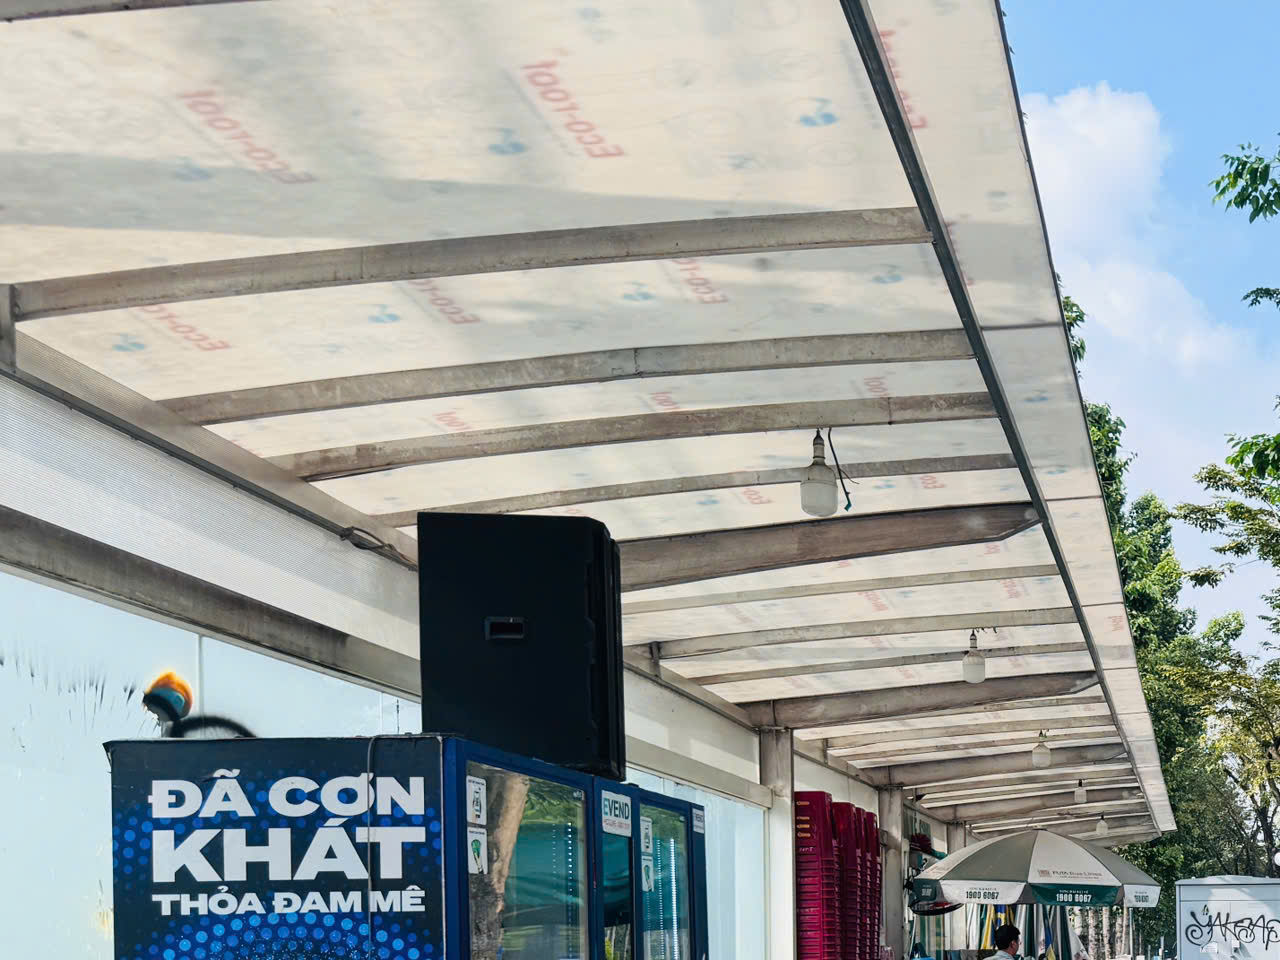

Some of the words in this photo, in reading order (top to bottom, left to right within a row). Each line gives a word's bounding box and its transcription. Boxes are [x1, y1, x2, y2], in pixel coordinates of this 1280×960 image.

[148, 768, 256, 819] ĐÃ
[268, 772, 425, 818] CƠN
[603, 797, 630, 820] EVEND
[152, 817, 426, 883] KHÁT
[152, 885, 266, 916] THỎA
[272, 891, 362, 914] ĐAM
[369, 885, 426, 913] MÊ
[1056, 893, 1073, 902] 1900
